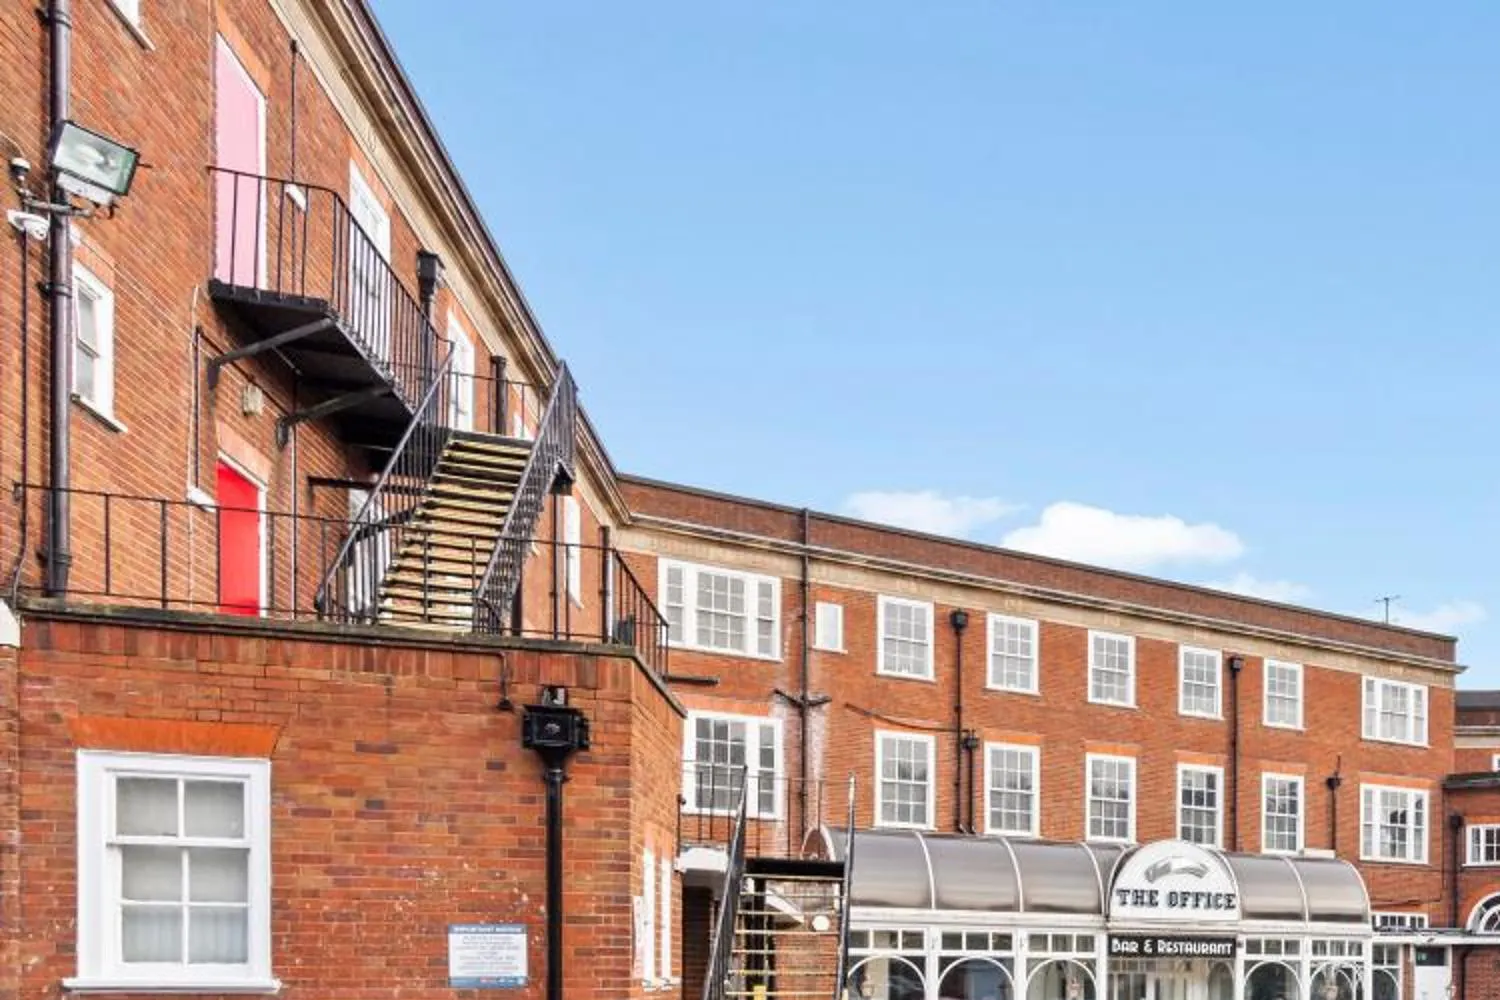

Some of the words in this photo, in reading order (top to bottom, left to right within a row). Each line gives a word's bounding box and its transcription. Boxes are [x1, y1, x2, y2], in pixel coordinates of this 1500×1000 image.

[1116, 888, 1159, 907] THE
[1168, 890, 1236, 910] OFFICE
[1111, 938, 1139, 953] BAR
[1143, 939, 1153, 953] &
[1157, 939, 1233, 955] RESTAURANT
